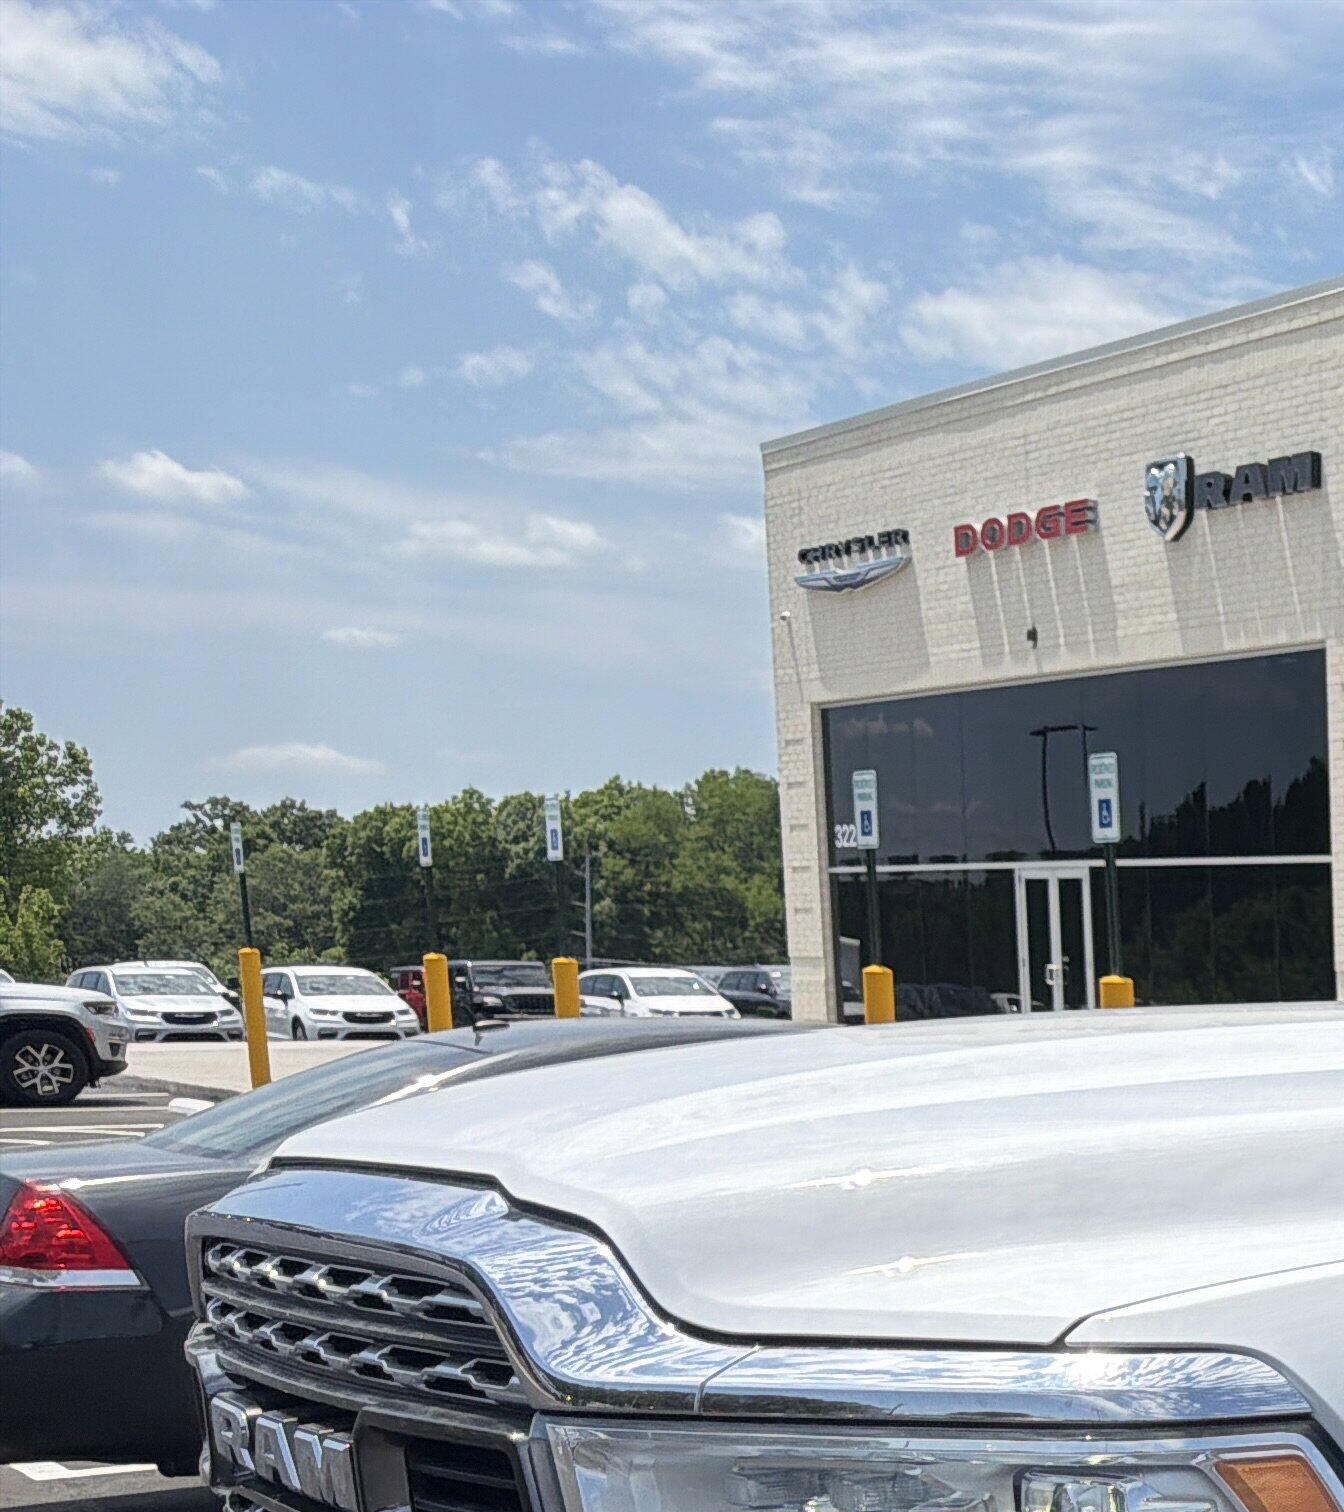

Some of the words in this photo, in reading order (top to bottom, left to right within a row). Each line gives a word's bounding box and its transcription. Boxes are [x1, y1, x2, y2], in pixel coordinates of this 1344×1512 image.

[1194, 451, 1322, 509] RAM
[798, 529, 910, 564] CHRYSLER
[953, 498, 1098, 558] DODGE
